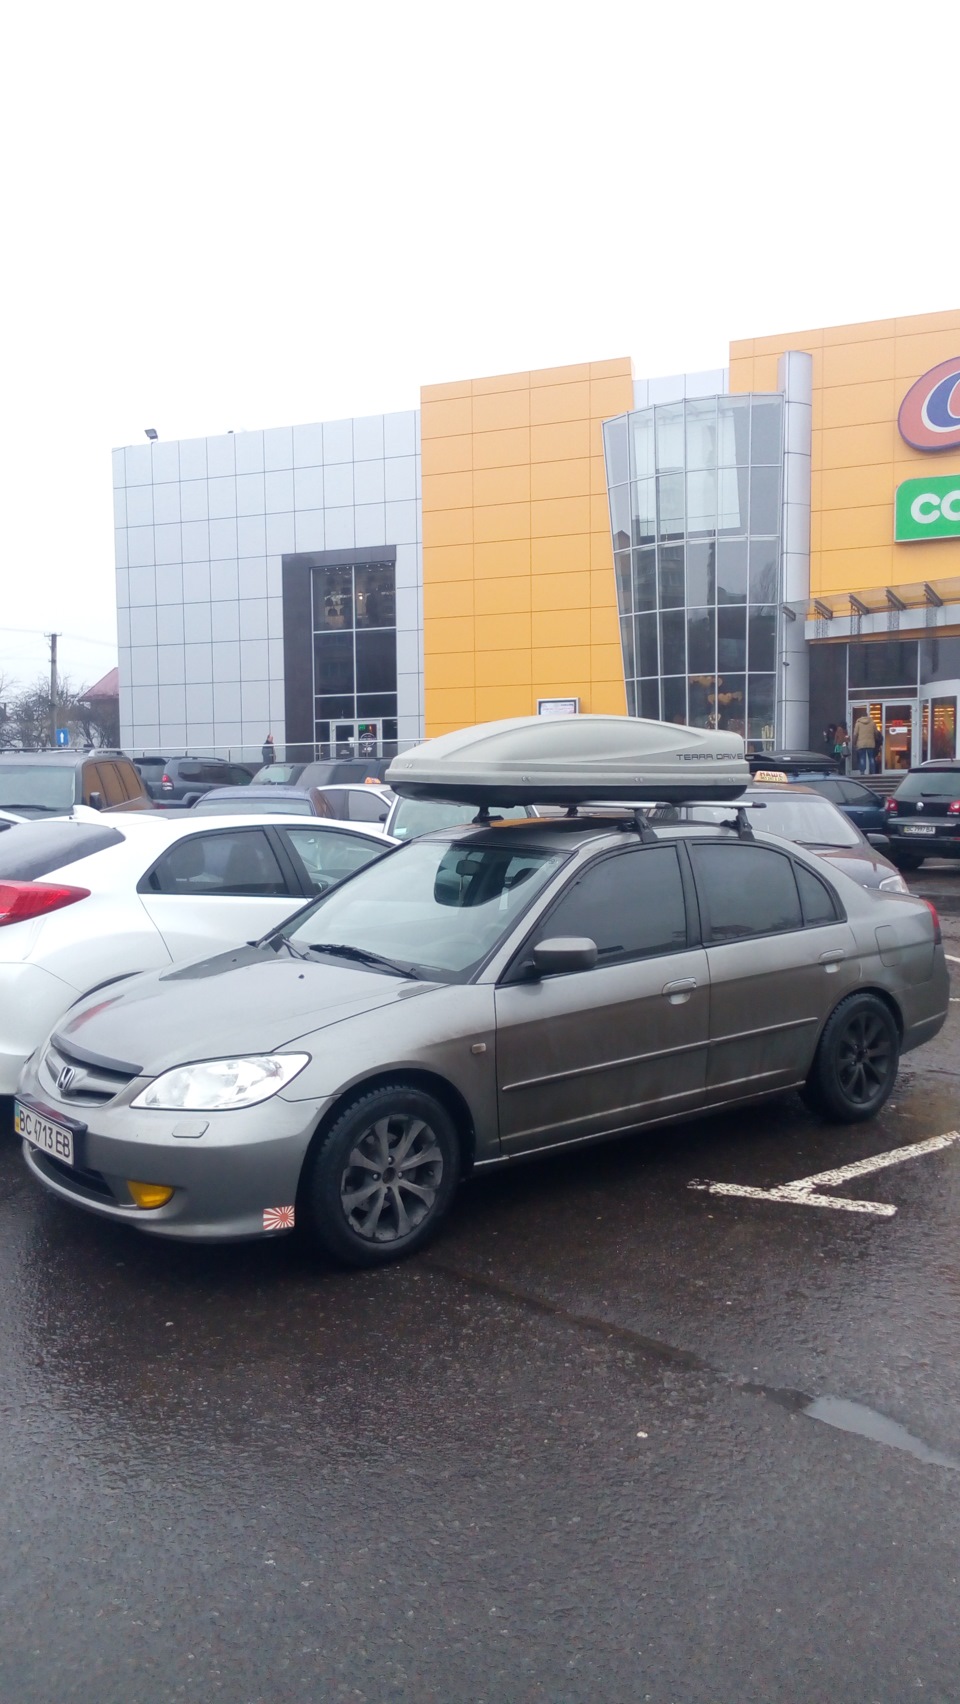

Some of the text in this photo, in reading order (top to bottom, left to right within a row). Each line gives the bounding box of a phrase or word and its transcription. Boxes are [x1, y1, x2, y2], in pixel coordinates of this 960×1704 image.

[19, 1109, 71, 1158] BC 4713 EB
